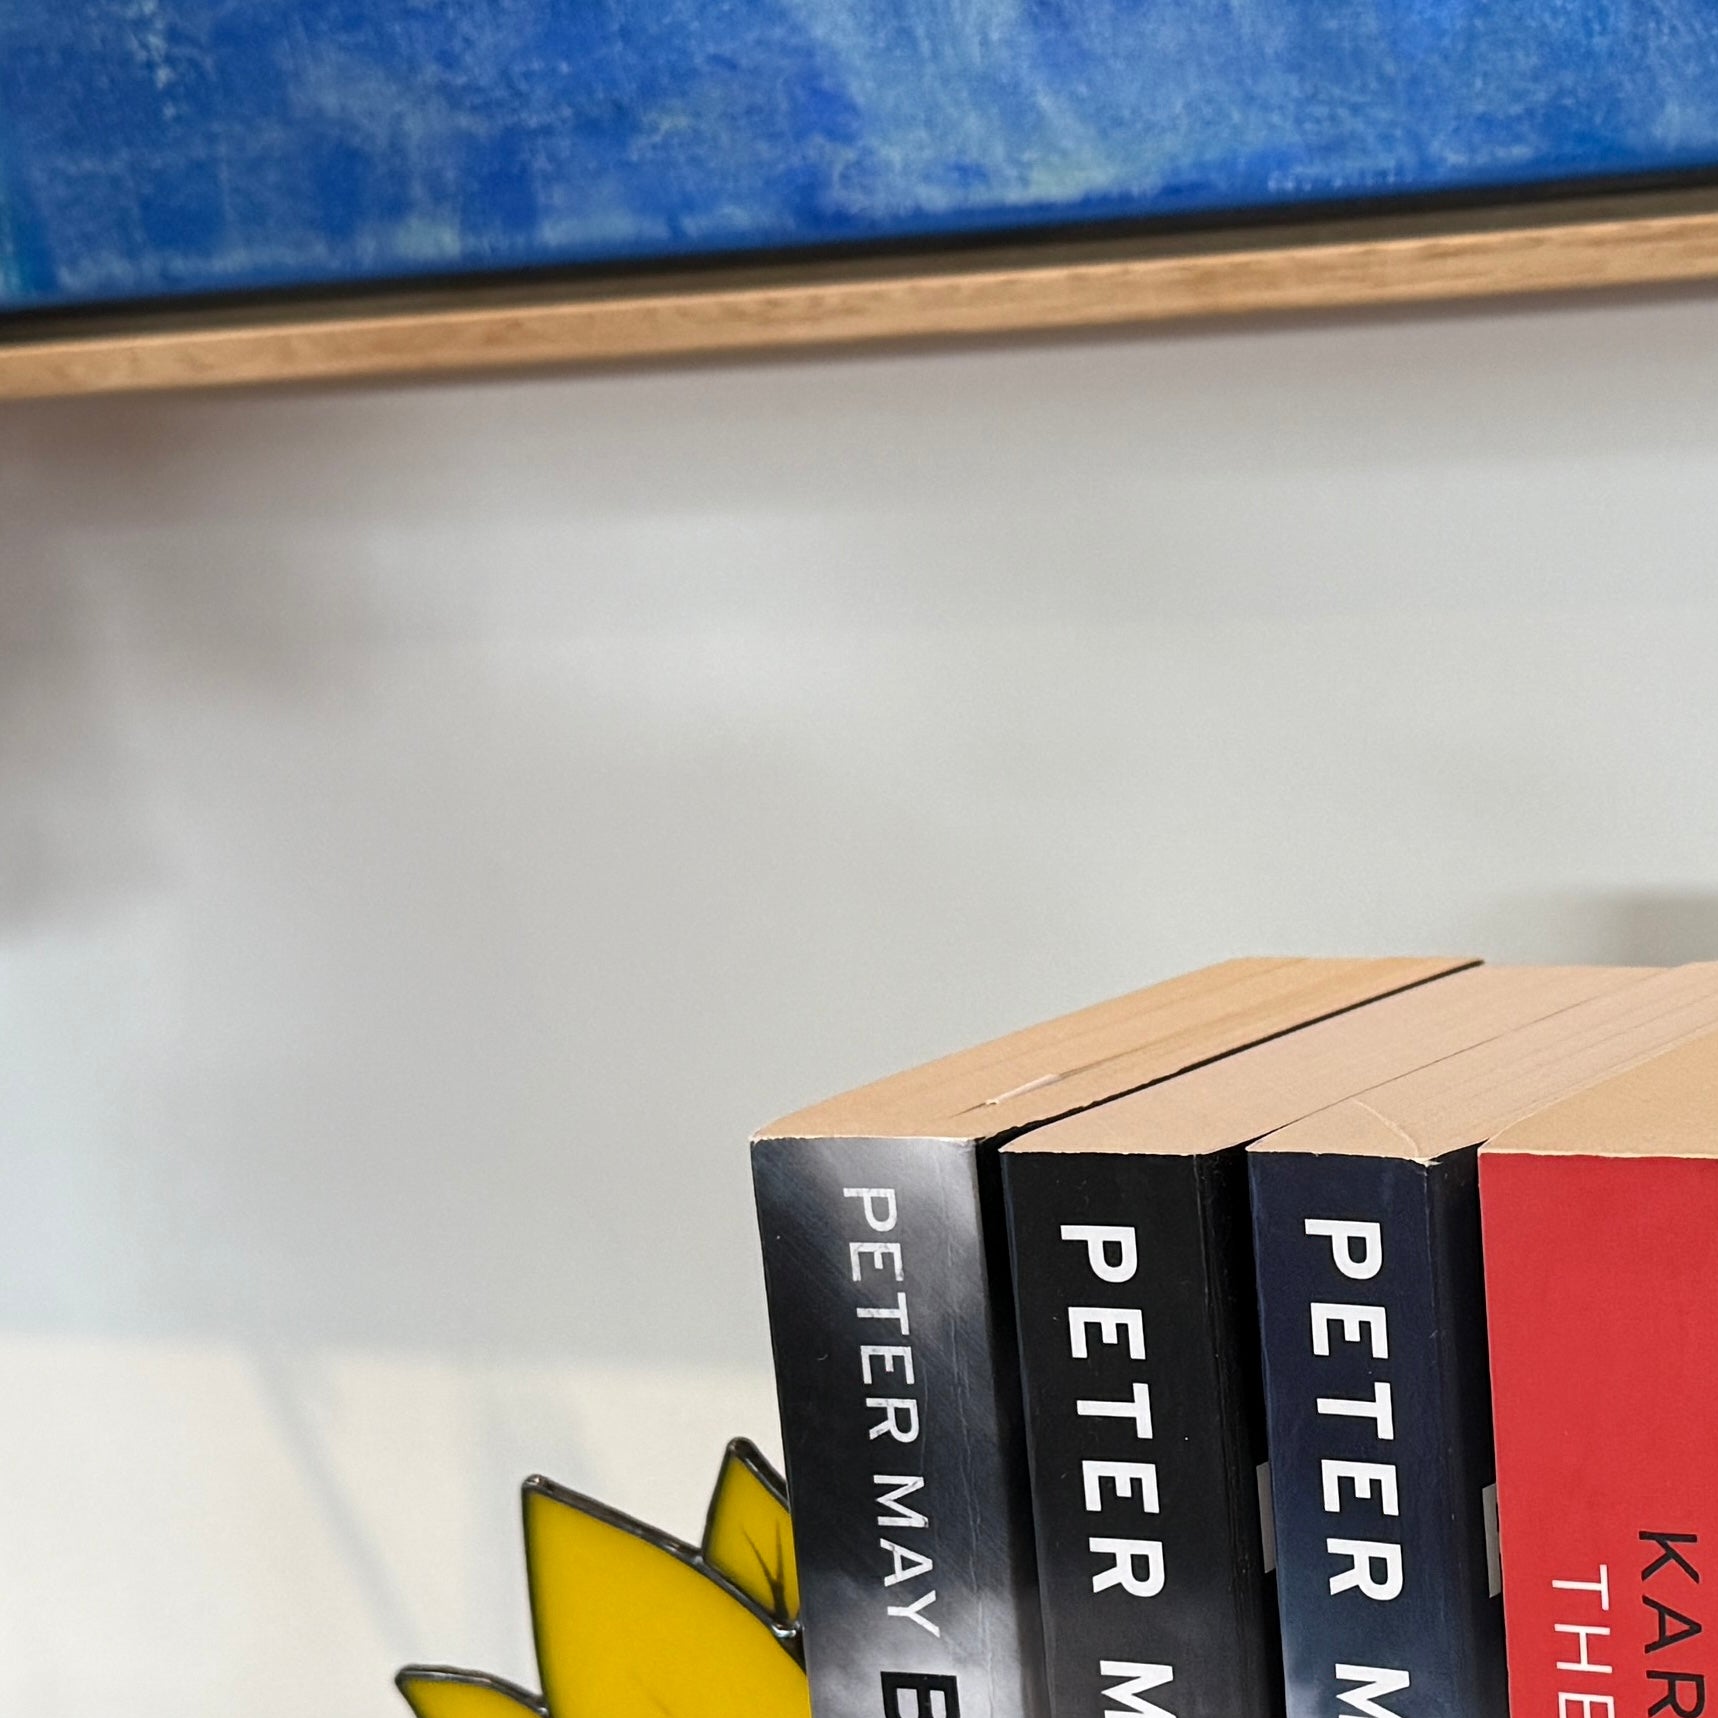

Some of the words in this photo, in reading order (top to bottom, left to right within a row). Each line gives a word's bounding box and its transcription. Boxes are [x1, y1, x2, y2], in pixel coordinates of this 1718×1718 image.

[843, 1186, 921, 1445] PETER
[1060, 1224, 1166, 1598] PETER
[1303, 1218, 1404, 1602] PETER
[870, 1474, 941, 1640] MAY
